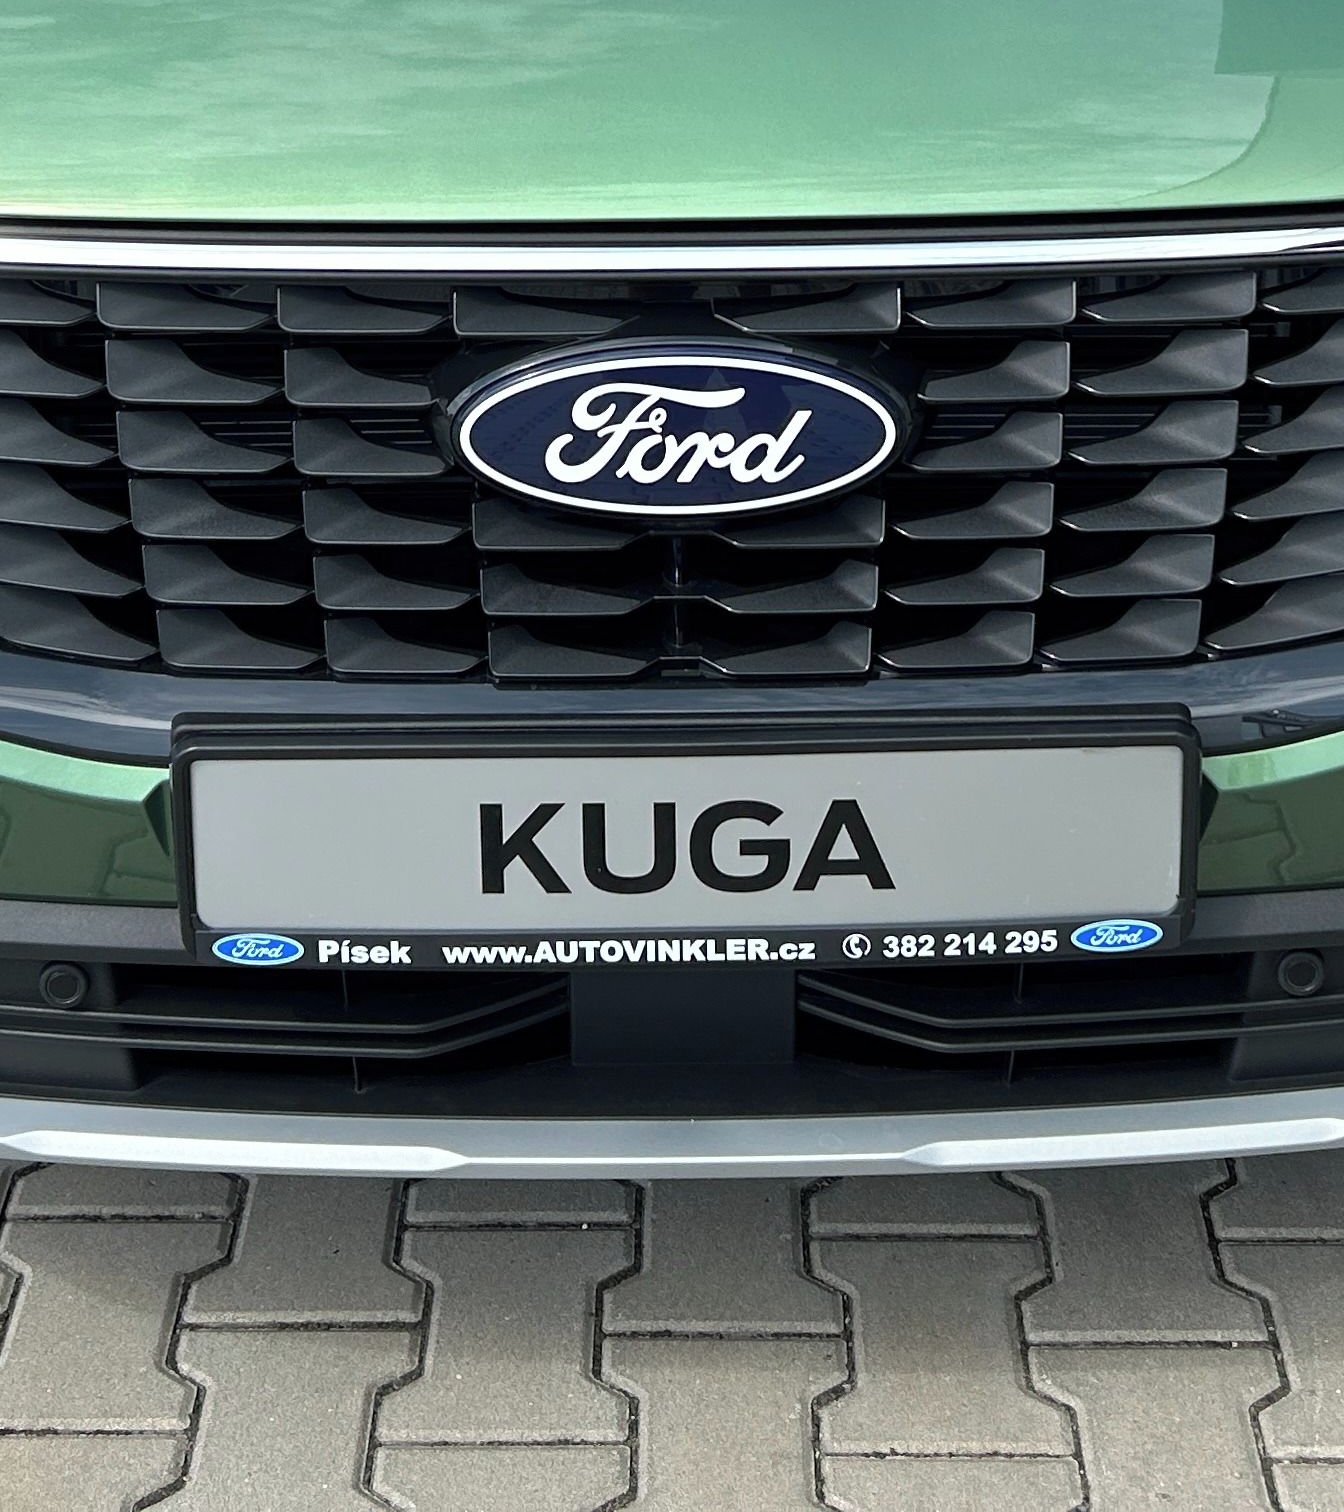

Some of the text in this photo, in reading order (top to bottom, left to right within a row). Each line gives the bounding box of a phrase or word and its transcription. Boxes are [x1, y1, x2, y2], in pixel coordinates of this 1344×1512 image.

[544, 382, 813, 484] Ford
[478, 797, 896, 895] KUGA
[231, 925, 1143, 965] Ford Písek www.AUTOVINKLER.cz 382 214 295 Ford
